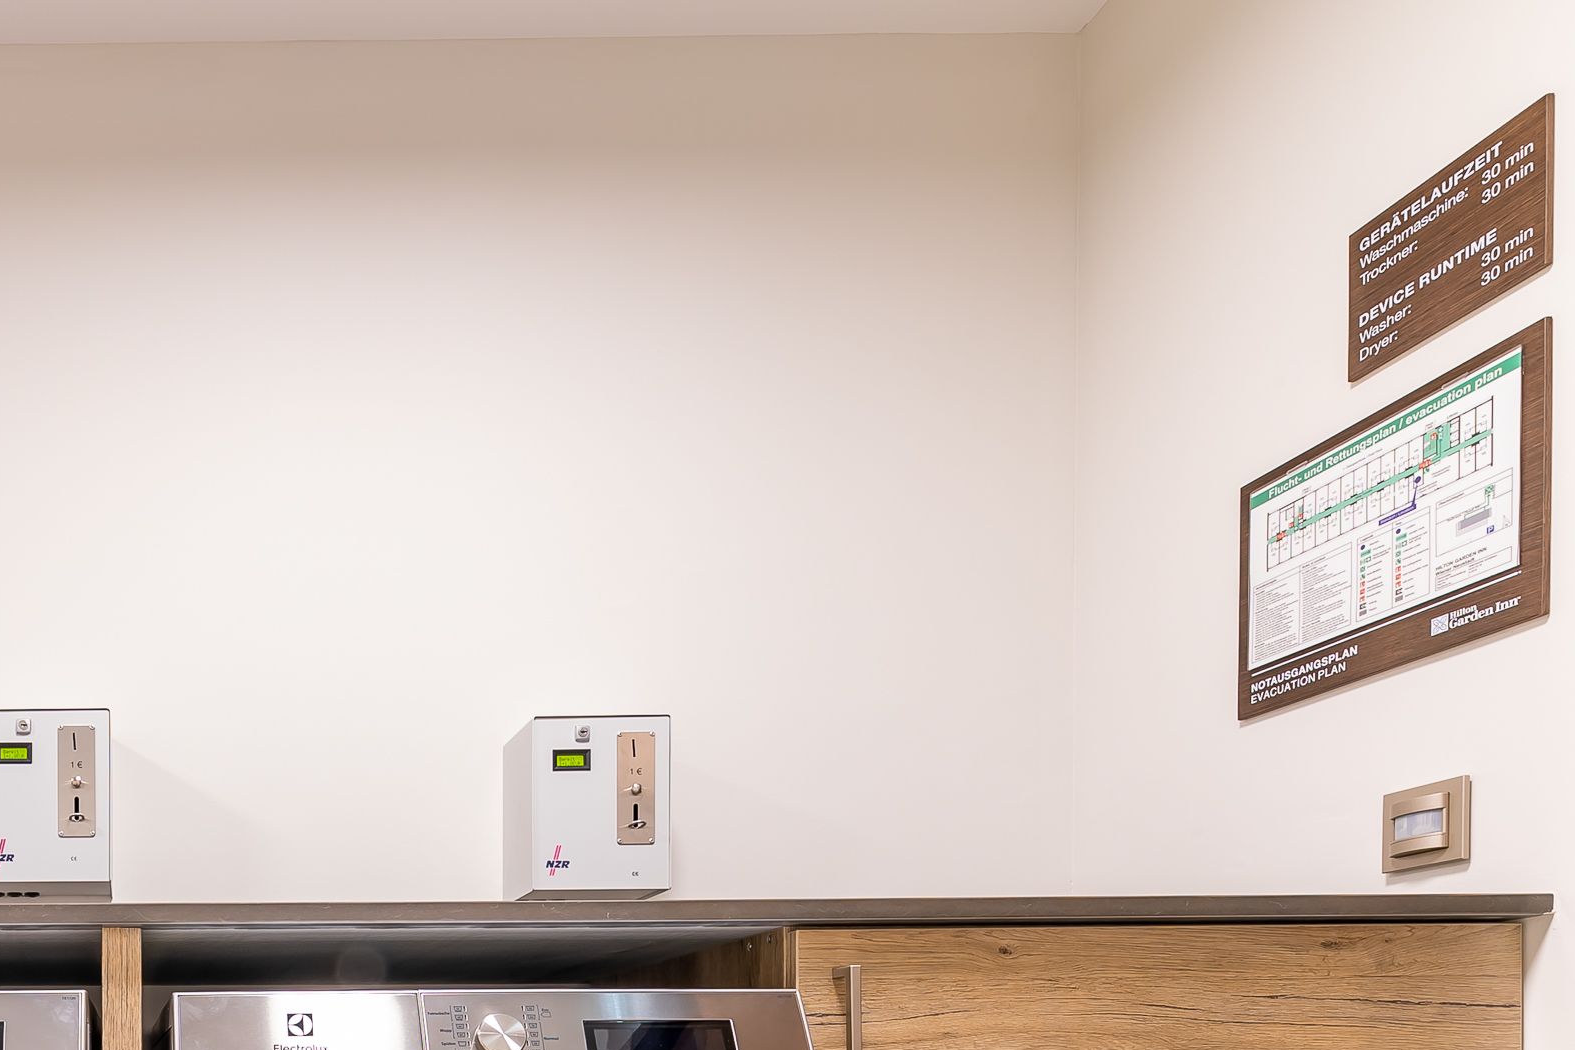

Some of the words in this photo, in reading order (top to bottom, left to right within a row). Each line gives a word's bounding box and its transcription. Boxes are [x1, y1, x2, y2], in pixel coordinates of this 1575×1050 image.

[1359, 141, 1503, 251] GERÄTELAUFZEIT
[1359, 239, 1418, 286] Trockner:
[1481, 186, 1500, 205] 30
[1505, 161, 1534, 189] min
[1360, 187, 1469, 269] Waschmaschine:
[1481, 167, 1500, 185] 30
[1505, 142, 1534, 170] min
[1359, 282, 1415, 328] DEVICE
[1418, 228, 1498, 290] RUNTIME
[1359, 304, 1412, 344] Washer:
[1480, 249, 1500, 268] 30
[1505, 226, 1534, 252] min
[1359, 330, 1398, 362] Dryer:
[1480, 268, 1500, 287] 30
[1505, 246, 1534, 272] min
[1268, 477, 1302, 499] Flucht-
[1304, 463, 1323, 481] und
[1326, 424, 1396, 468] Rettungsplan
[1406, 381, 1472, 424] evacuation
[1475, 367, 1503, 391] plan
[1449, 604, 1478, 620] Hilton
[1449, 607, 1494, 629] Garden
[1495, 598, 1520, 613] Inn
[1250, 645, 1358, 693] NOTAUSGANGSPLAN
[1250, 672, 1316, 705] EVACUATION
[1317, 661, 1346, 680] PLAN
[546, 860, 570, 869] NZR
